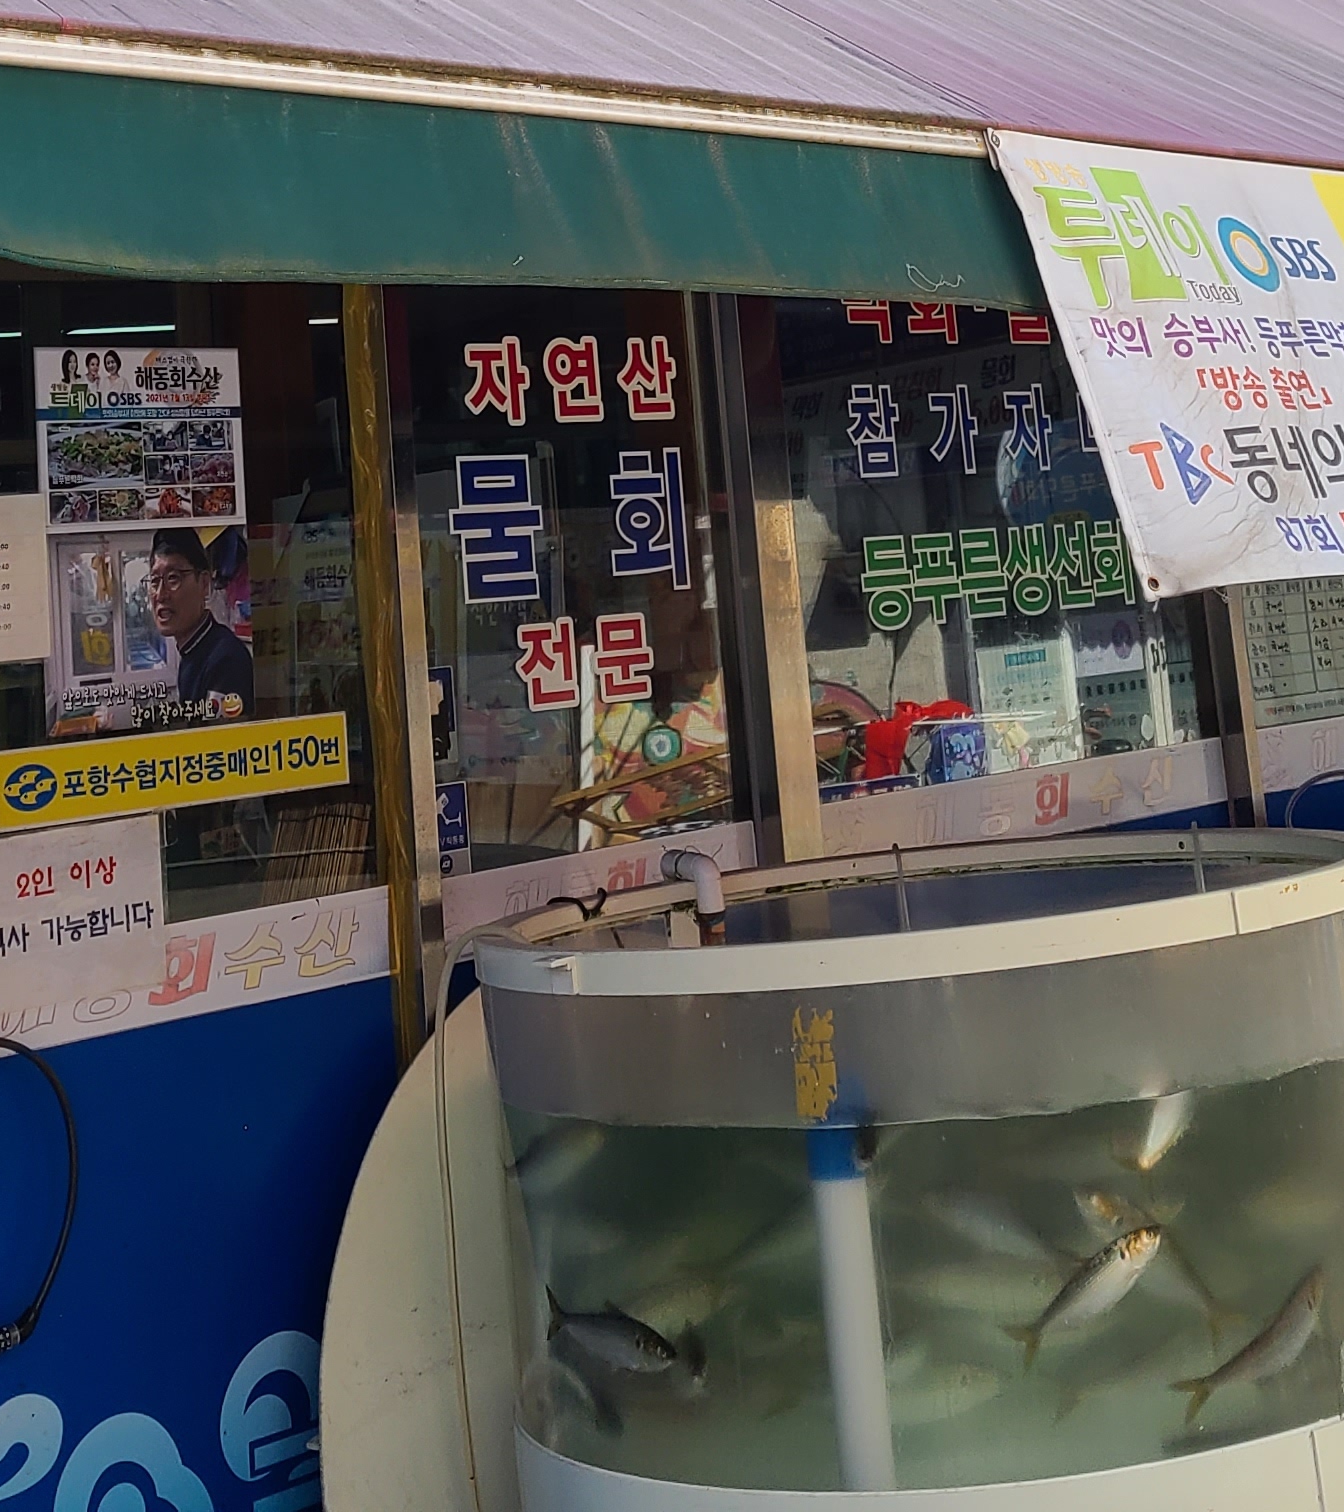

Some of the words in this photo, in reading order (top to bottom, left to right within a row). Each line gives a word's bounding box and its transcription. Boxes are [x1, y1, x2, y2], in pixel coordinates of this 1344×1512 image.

[1033, 167, 1231, 310] 투데이
[1269, 235, 1338, 283] SBS
[1186, 279, 1243, 306] Today
[1089, 316, 1153, 359] 맛의
[1163, 315, 1257, 359] 승부사!
[119, 392, 142, 406] SBS
[134, 366, 221, 391] 해동회수산
[464, 335, 677, 427] 자연산
[448, 447, 692, 605] 물회
[860, 519, 1136, 632] 등푸른생선회
[516, 612, 655, 713] 전문
[62, 735, 342, 800] 포항수협지정중매인150번
[15, 865, 55, 899] 2인
[69, 855, 118, 891] 이상
[41, 902, 155, 947] 가능합니다
